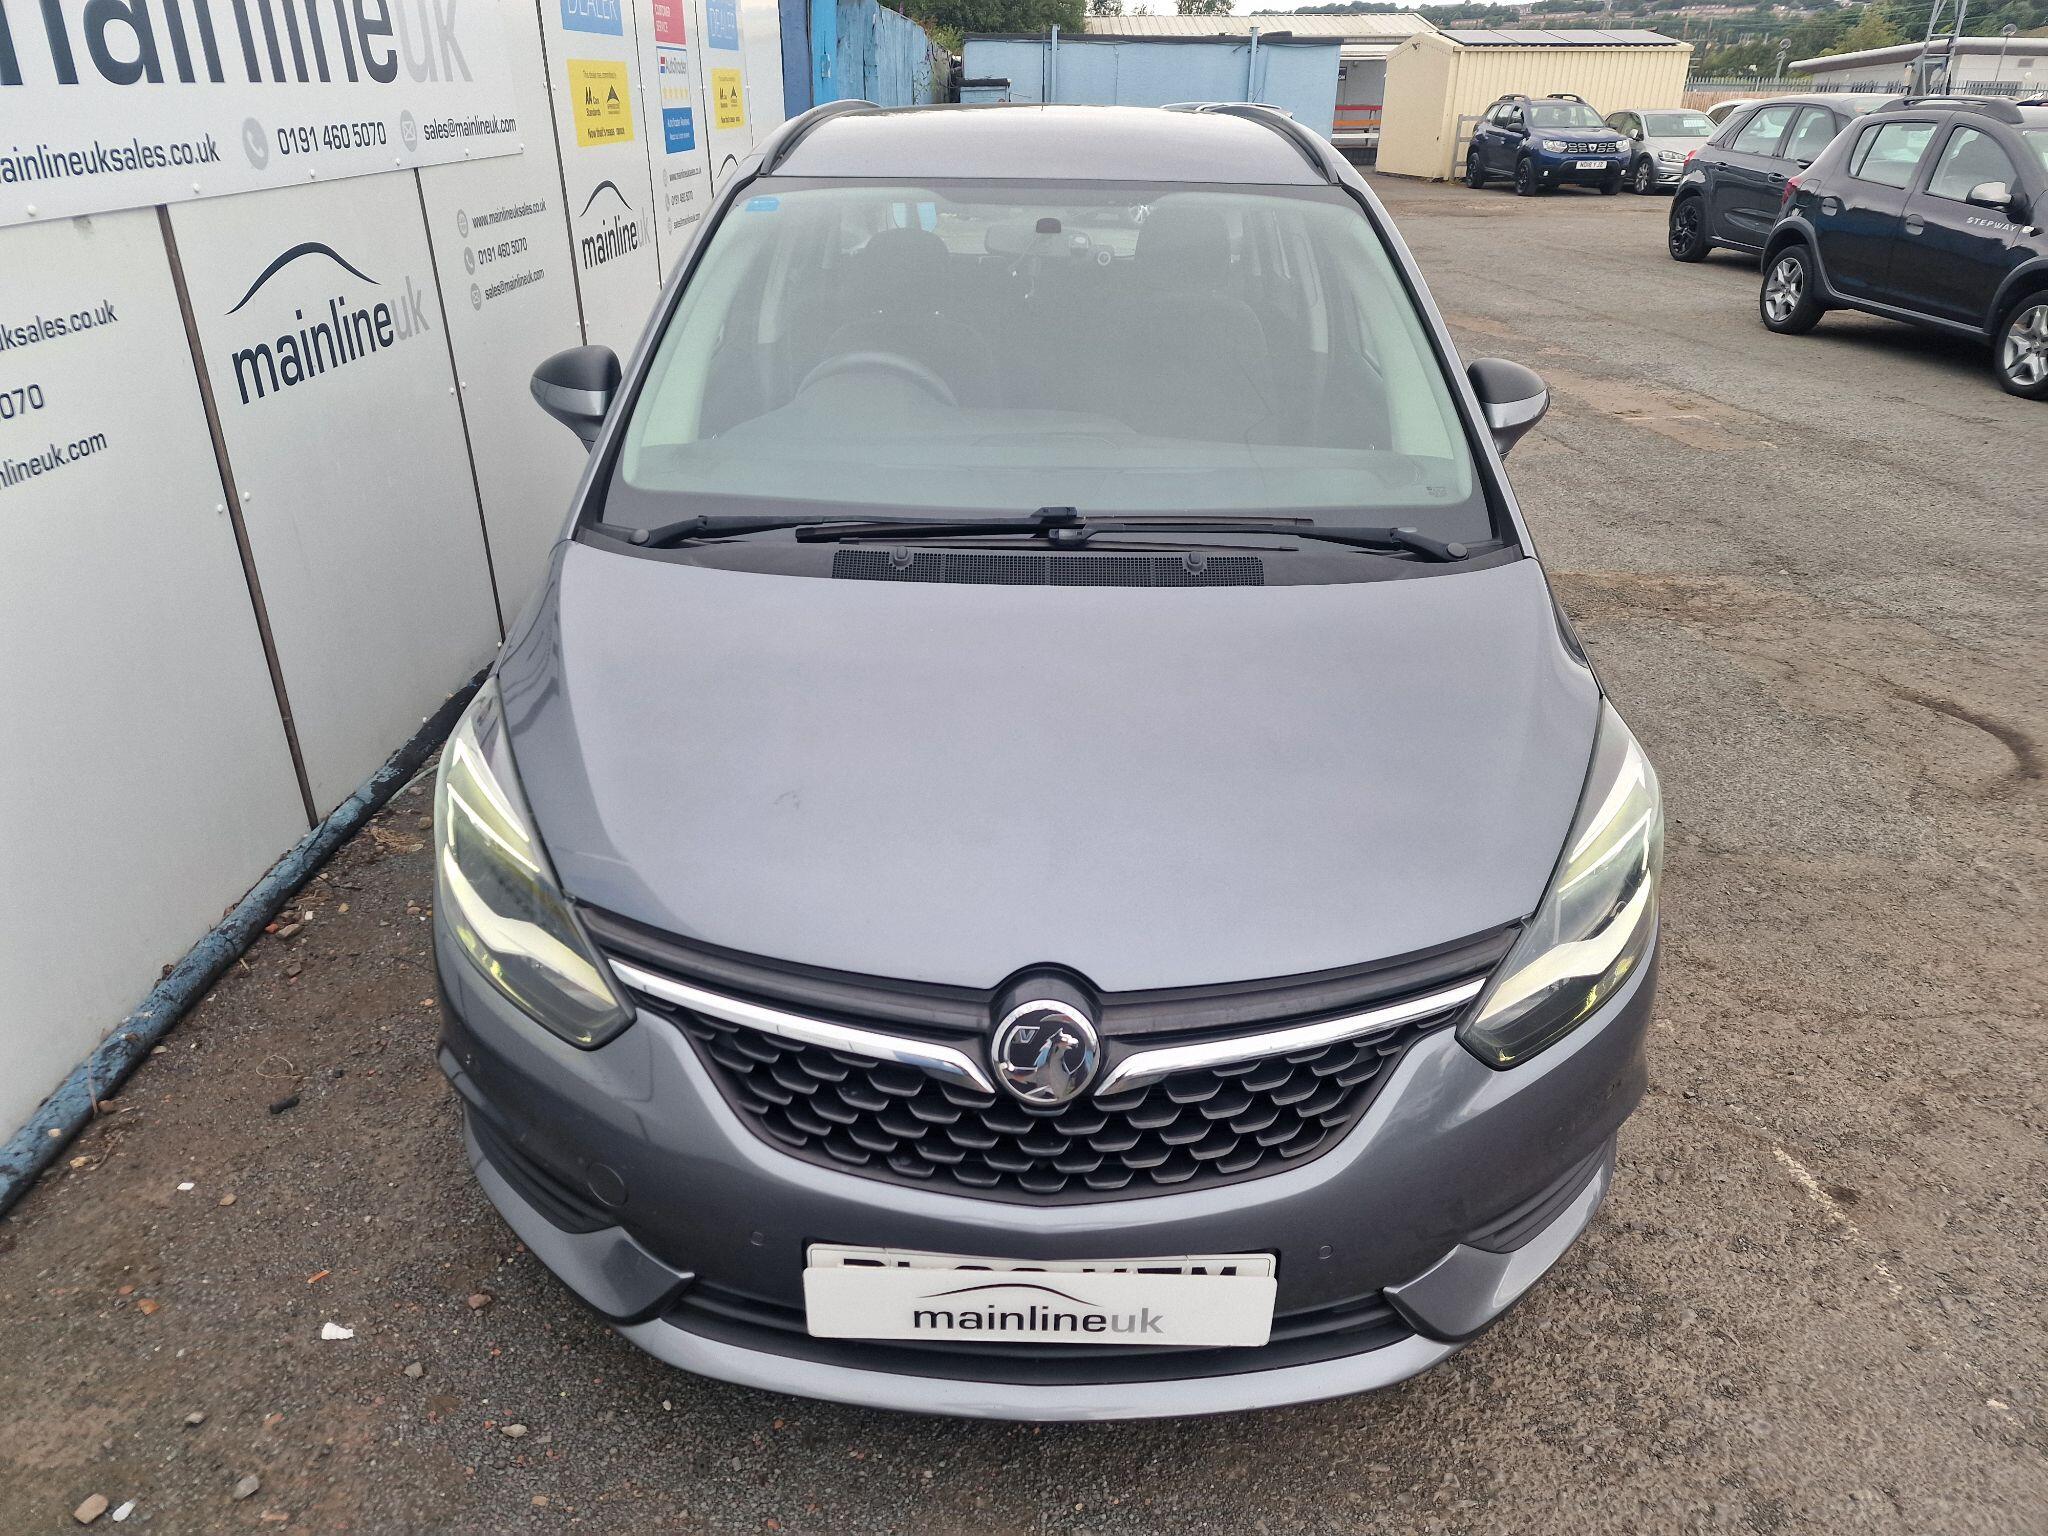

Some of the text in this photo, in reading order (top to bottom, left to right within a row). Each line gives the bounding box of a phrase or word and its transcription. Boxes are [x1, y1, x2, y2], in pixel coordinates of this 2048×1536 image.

[277, 121, 388, 156] 0191 460 5070
[423, 115, 518, 142] sales@mainlineuk.com
[0, 133, 221, 184] ainlineuksales.co.uk
[1966, 216, 2018, 232] STEPWAY
[478, 236, 528, 265] 0191 460 5070
[231, 275, 431, 405] mainlineuk
[0, 384, 45, 420] 070
[913, 1303, 1164, 1335] mainlineuk
